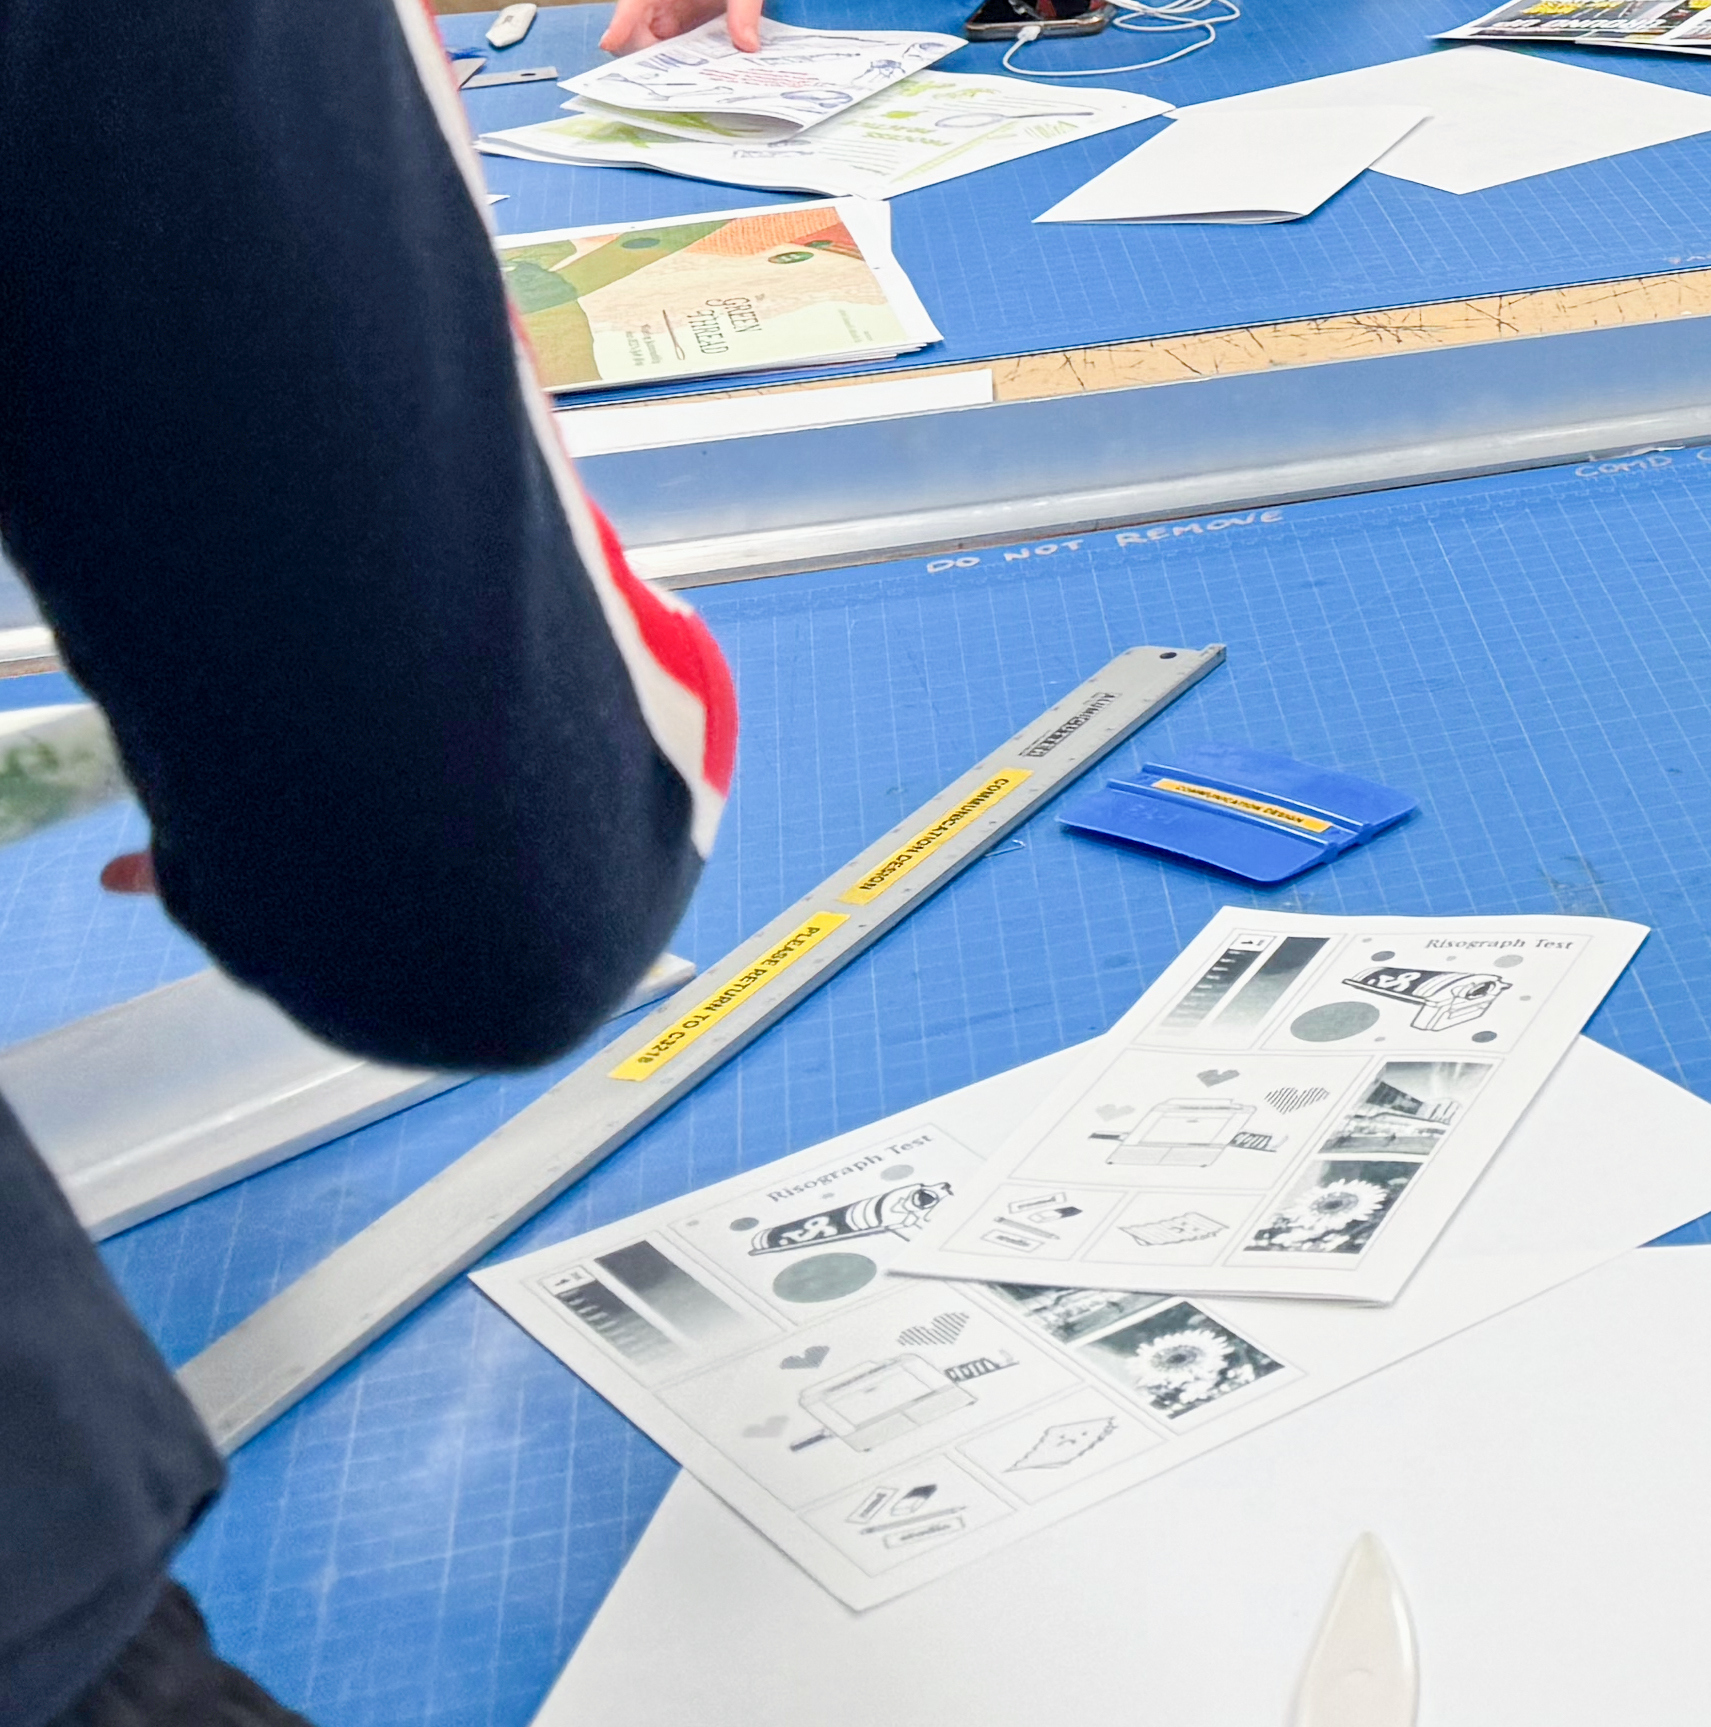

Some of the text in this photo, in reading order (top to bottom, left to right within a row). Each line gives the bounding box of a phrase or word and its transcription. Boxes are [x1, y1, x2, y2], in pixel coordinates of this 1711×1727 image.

[686, 309, 730, 355] THREAD
[707, 296, 762, 334] GREEN
[1573, 452, 1674, 480] COMD
[926, 507, 1285, 575] DO NOT REMOVE
[1172, 783, 1307, 825] COMMUNICATION DESIGN
[859, 775, 1011, 893] COMMUNICATION DESIGN
[758, 924, 822, 980] PLEASE
[1425, 936, 1576, 954] Risograph Test
[703, 969, 766, 1020] RETURN
[766, 1129, 936, 1207] Risograph Test
